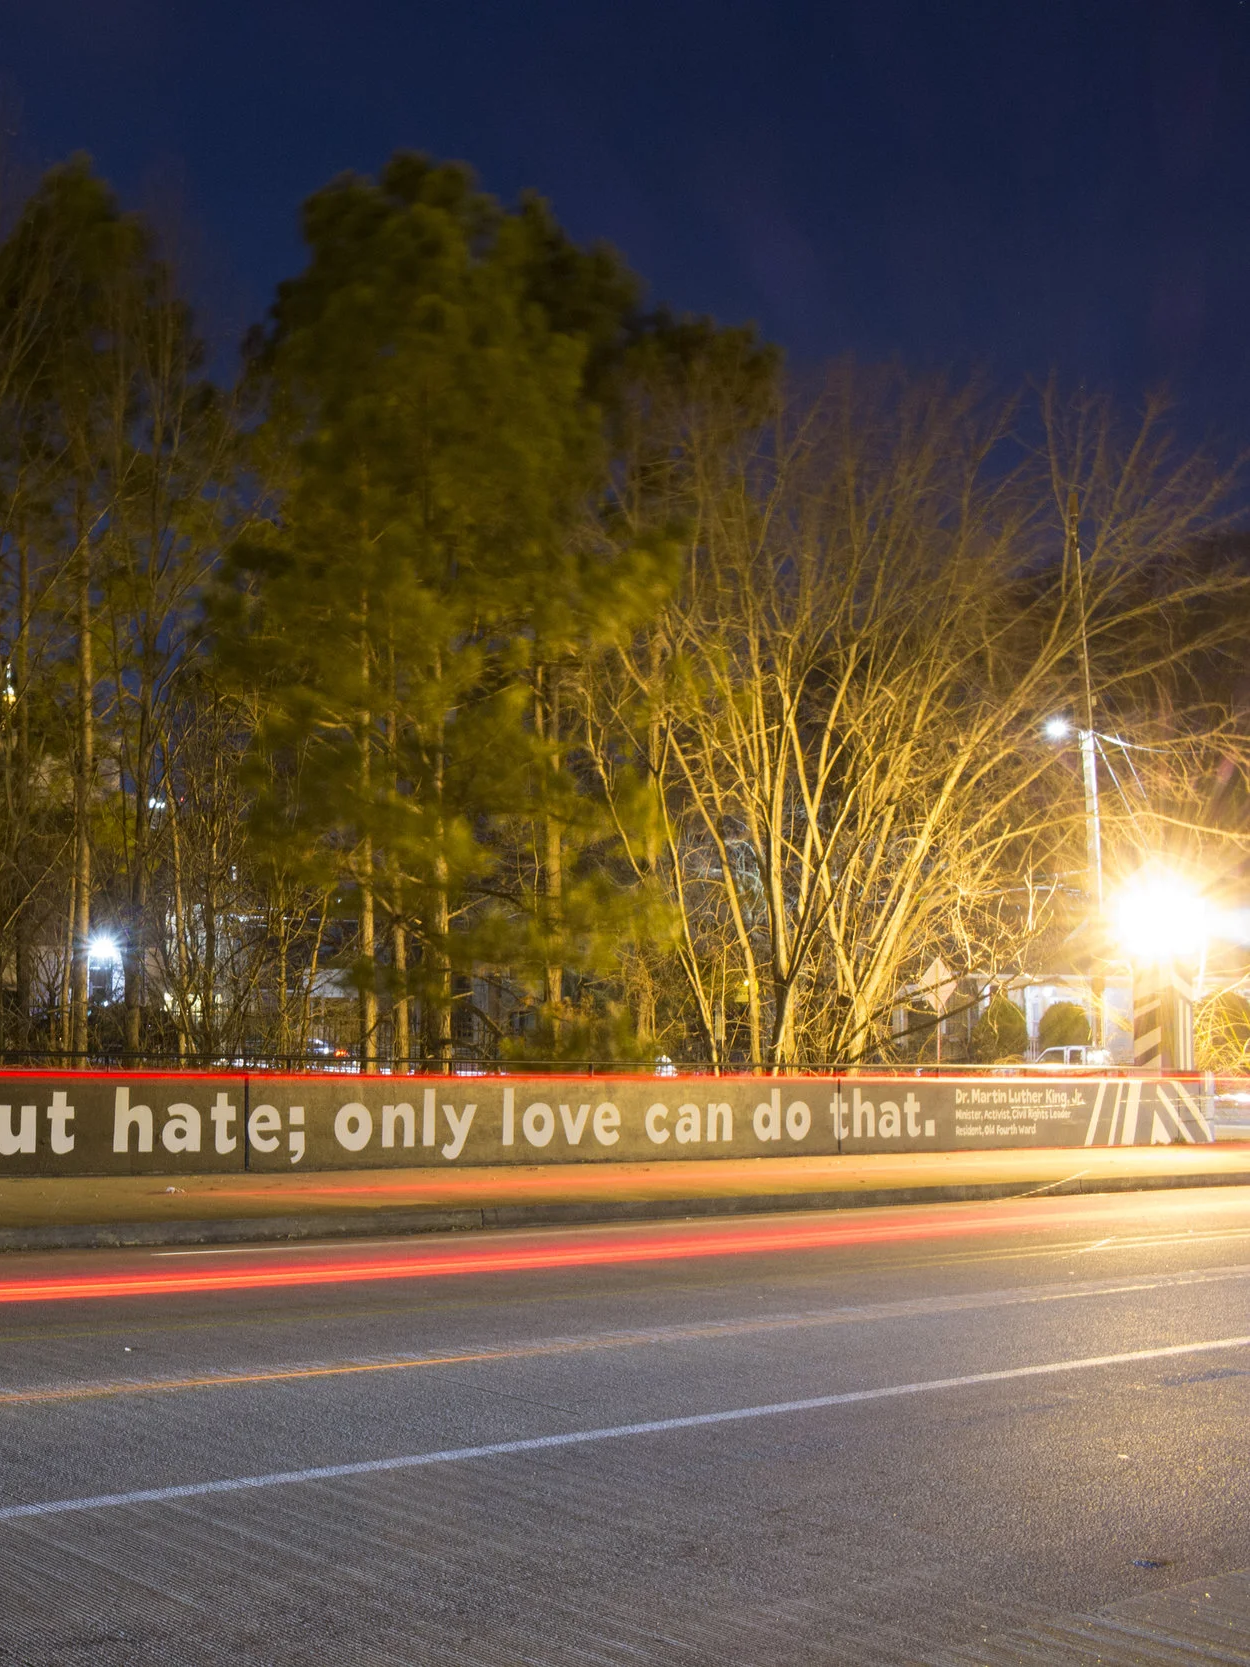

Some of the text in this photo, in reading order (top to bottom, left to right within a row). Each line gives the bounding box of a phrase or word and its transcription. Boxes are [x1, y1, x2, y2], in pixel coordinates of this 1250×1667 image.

[955, 1088, 1084, 1108] Dr. Martin Luther King, Jr.
[955, 1108, 1072, 1121] Minister, Activist, Civil Rights Leader
[113, 1087, 305, 1163] hate;
[335, 1088, 476, 1160] only
[503, 1088, 622, 1147] love
[646, 1102, 734, 1144] can
[753, 1088, 812, 1142] do
[830, 1088, 936, 1140] that.
[955, 1124, 1037, 1136] Resident, Old Fourth Ward
